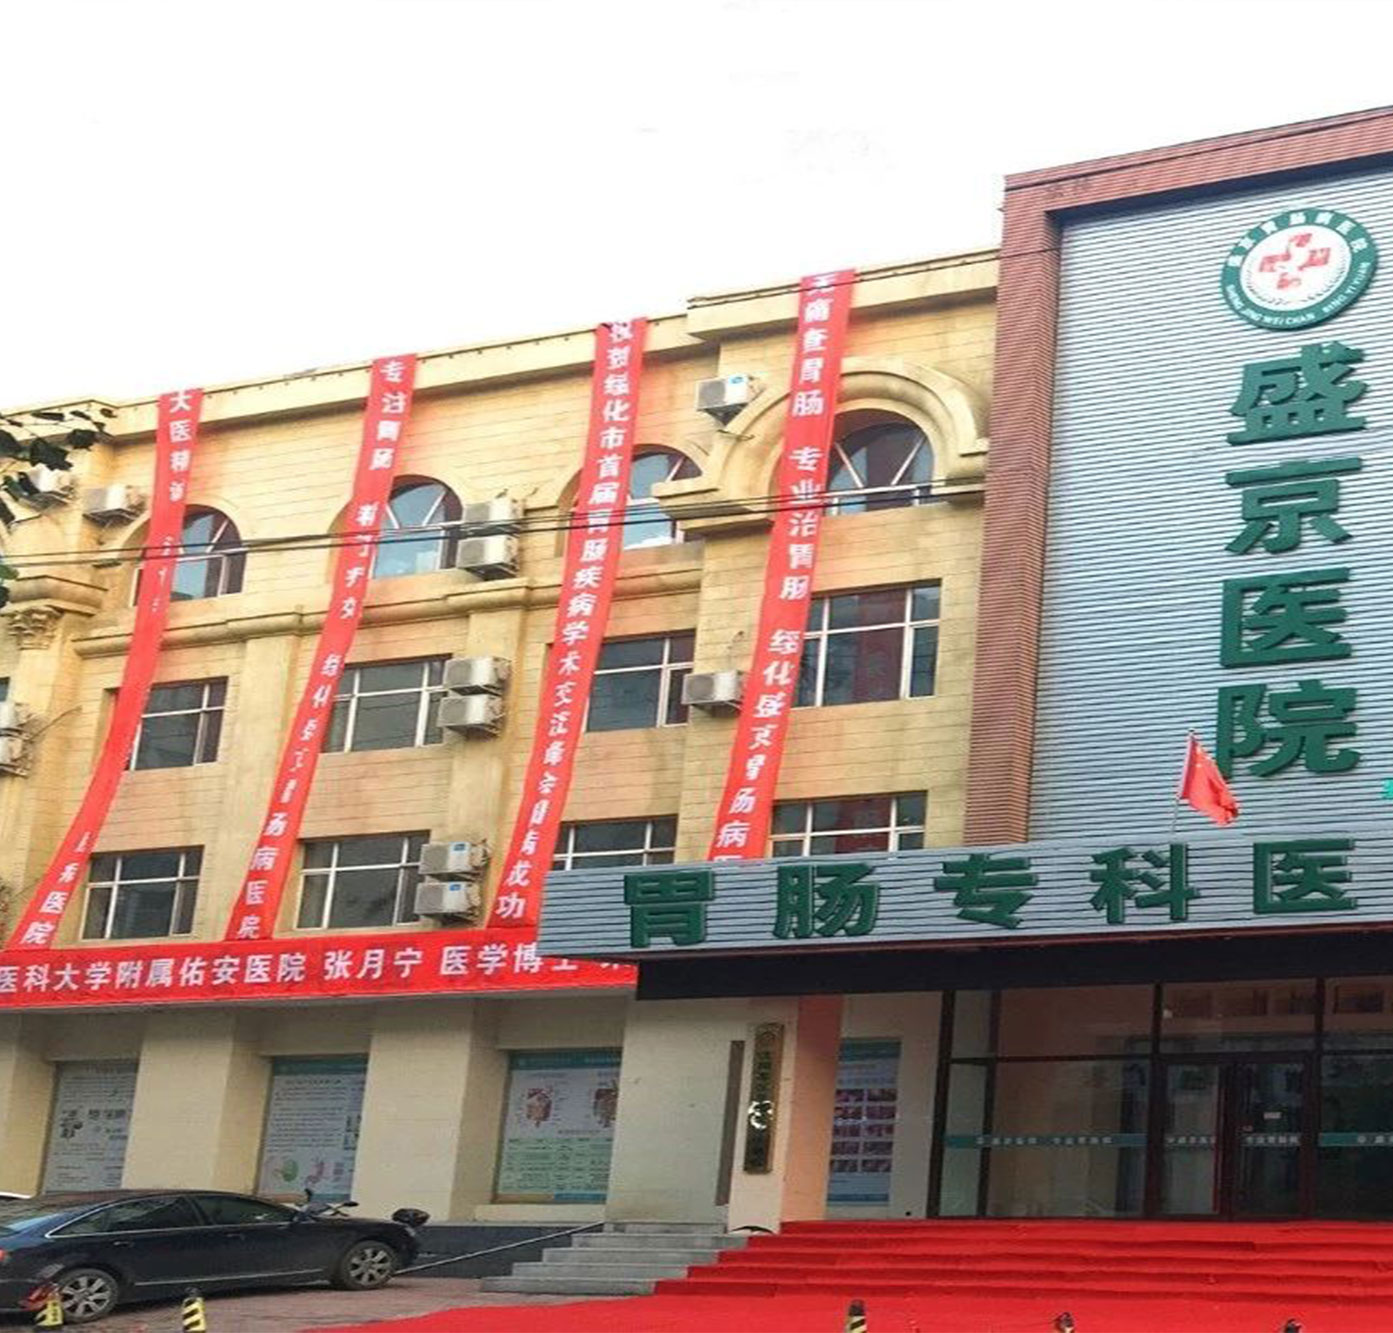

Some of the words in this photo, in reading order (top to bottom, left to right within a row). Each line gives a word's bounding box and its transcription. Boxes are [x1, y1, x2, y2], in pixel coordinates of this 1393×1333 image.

[780, 447, 822, 600] 专业治胃肠
[1217, 340, 1370, 781] 盛京医院
[0, 951, 309, 992] 医科大学附属佑安医院
[324, 947, 425, 980] 张月宁
